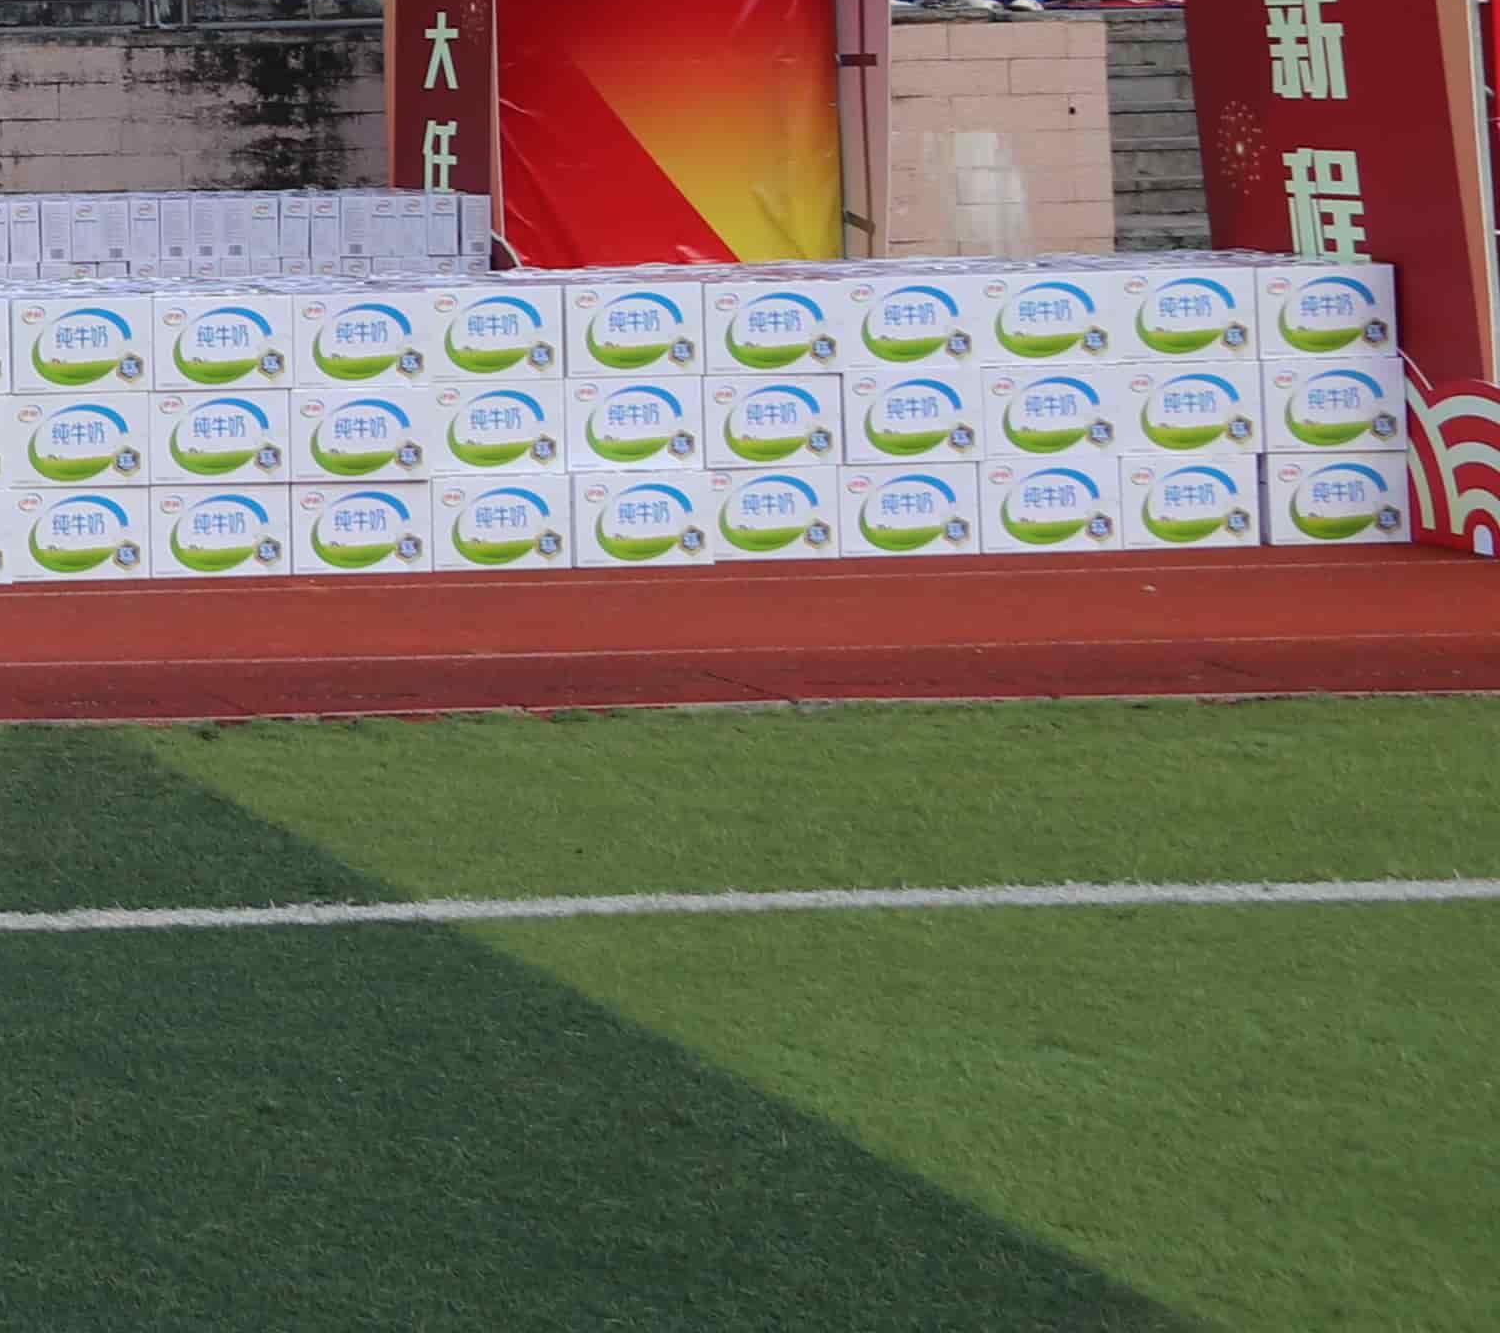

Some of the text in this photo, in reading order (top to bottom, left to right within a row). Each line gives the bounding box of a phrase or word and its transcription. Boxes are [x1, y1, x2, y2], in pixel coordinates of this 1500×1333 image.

[882, 302, 936, 327] 纯牛奶
[1017, 298, 1071, 323] 纯牛奶
[1158, 294, 1212, 319] 纯牛奶
[1299, 293, 1353, 318] 纯牛奶
[334, 320, 388, 345] 纯牛奶
[465, 313, 519, 338] 纯牛奶
[606, 308, 660, 333] 纯牛奶
[747, 309, 801, 334] 纯牛奶
[54, 325, 108, 350] 纯牛奶
[195, 323, 249, 348] 纯牛奶
[885, 395, 939, 420] 纯牛奶
[1023, 393, 1077, 418] 纯牛奶
[1162, 390, 1216, 415] 纯牛奶
[1306, 386, 1360, 411] 纯牛奶
[468, 406, 522, 431] 纯牛奶
[606, 402, 660, 427] 纯牛奶
[744, 401, 798, 426] 纯牛奶
[51, 421, 105, 446] 纯牛奶
[192, 414, 246, 439] 纯牛奶
[333, 415, 387, 440] 纯牛奶
[741, 491, 795, 516] 纯牛奶
[879, 491, 933, 516] 纯牛奶
[1022, 484, 1076, 509] 纯牛奶
[1162, 482, 1216, 507] 纯牛奶
[1311, 479, 1365, 504] 纯牛奶
[51, 512, 105, 537] 纯牛奶
[192, 511, 246, 536] 纯牛奶
[332, 507, 386, 532] 纯牛奶
[473, 504, 527, 529] 纯牛奶
[616, 500, 670, 525] 纯牛奶
